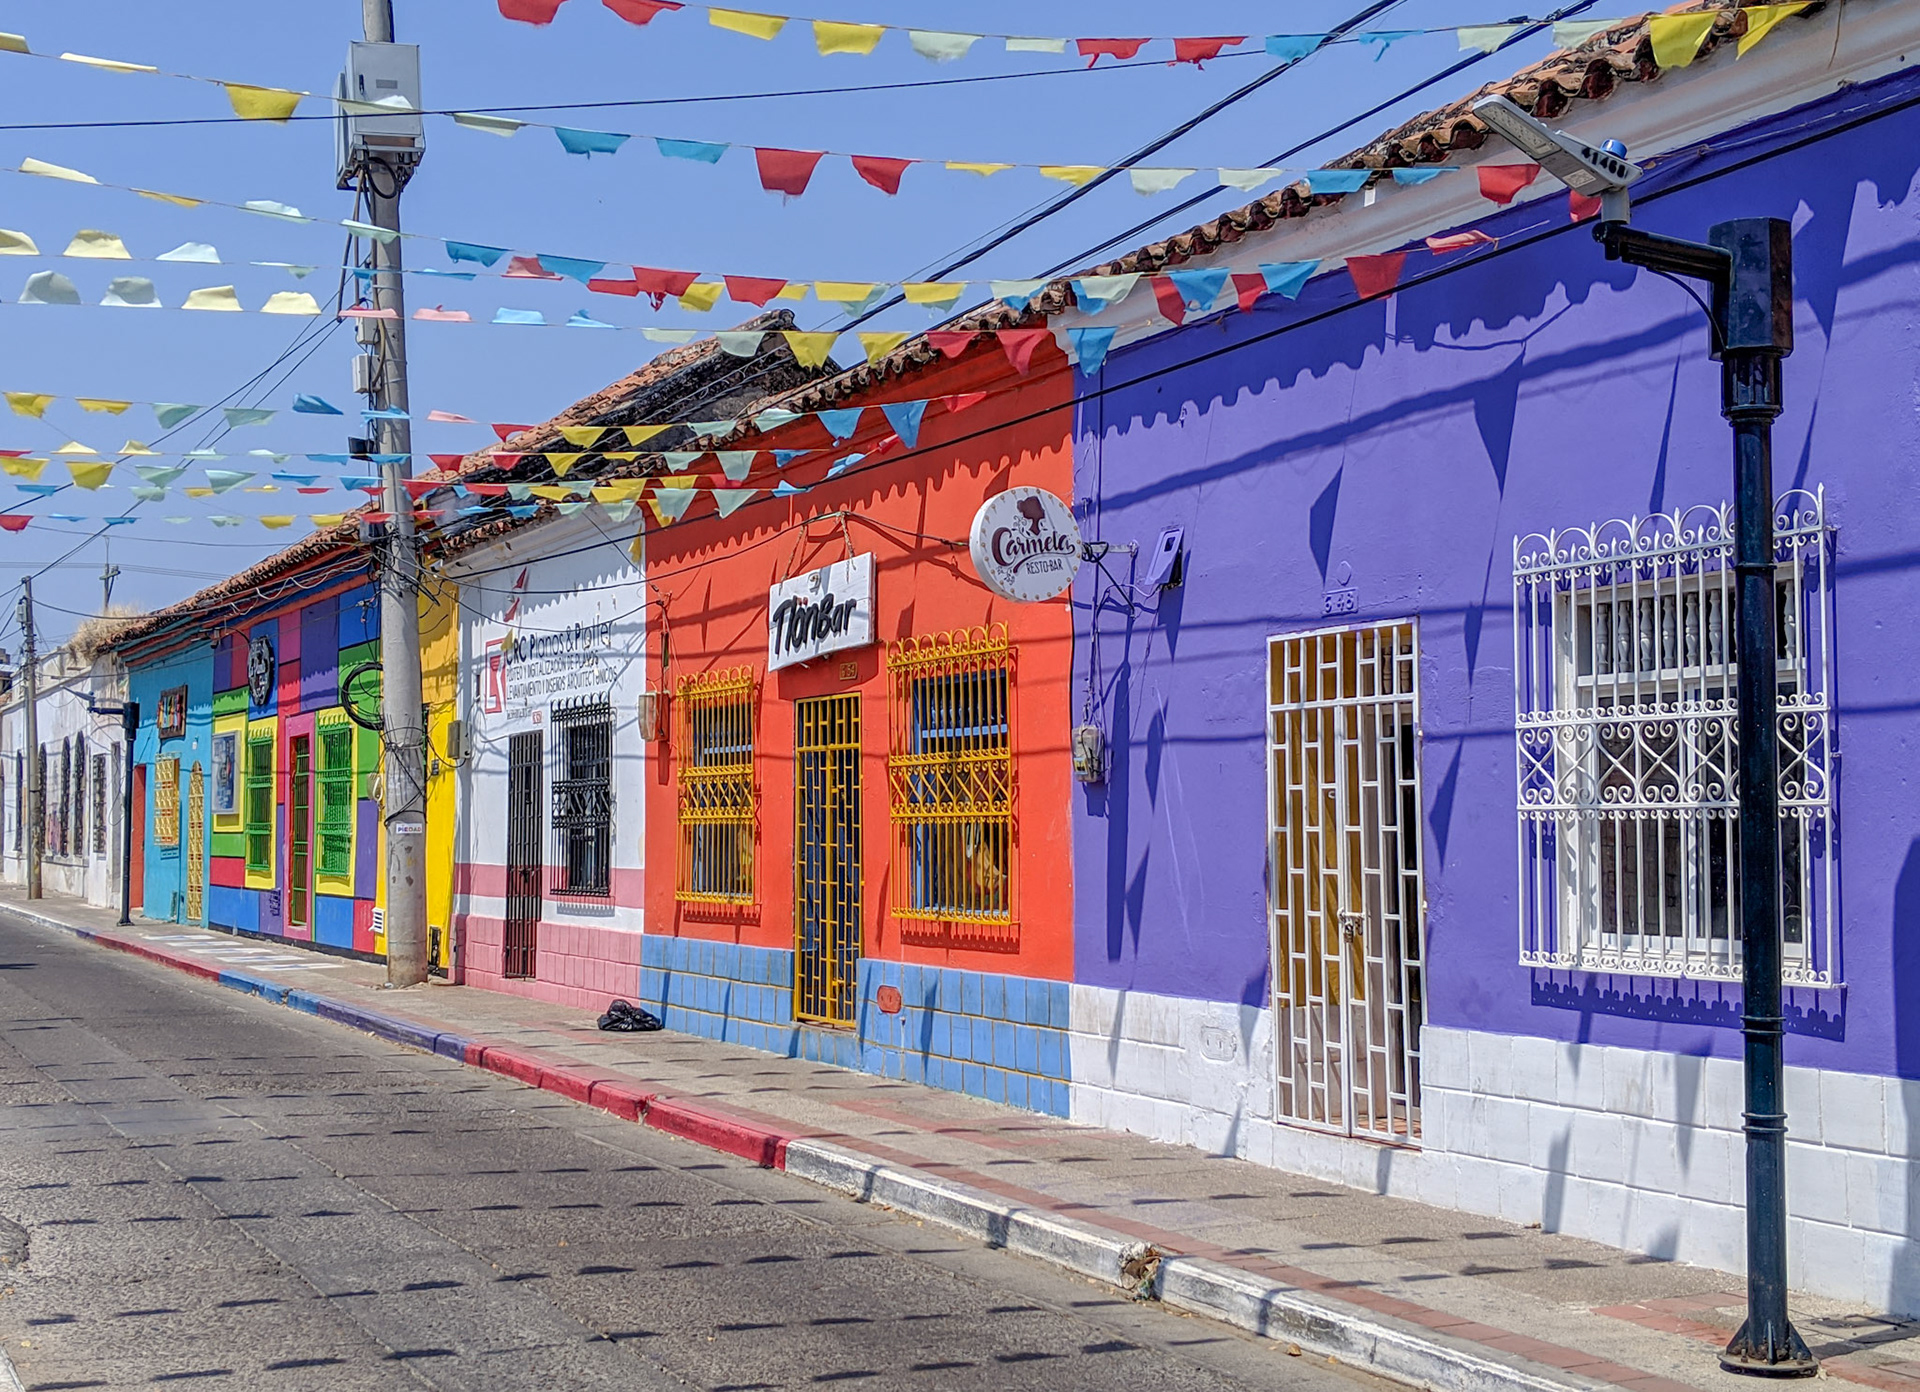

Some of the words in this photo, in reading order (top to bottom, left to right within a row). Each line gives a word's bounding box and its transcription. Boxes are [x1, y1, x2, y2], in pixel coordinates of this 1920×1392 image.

[991, 527, 1076, 567] Carmela
[529, 631, 564, 660] Planos
[575, 615, 613, 650] Plotter
